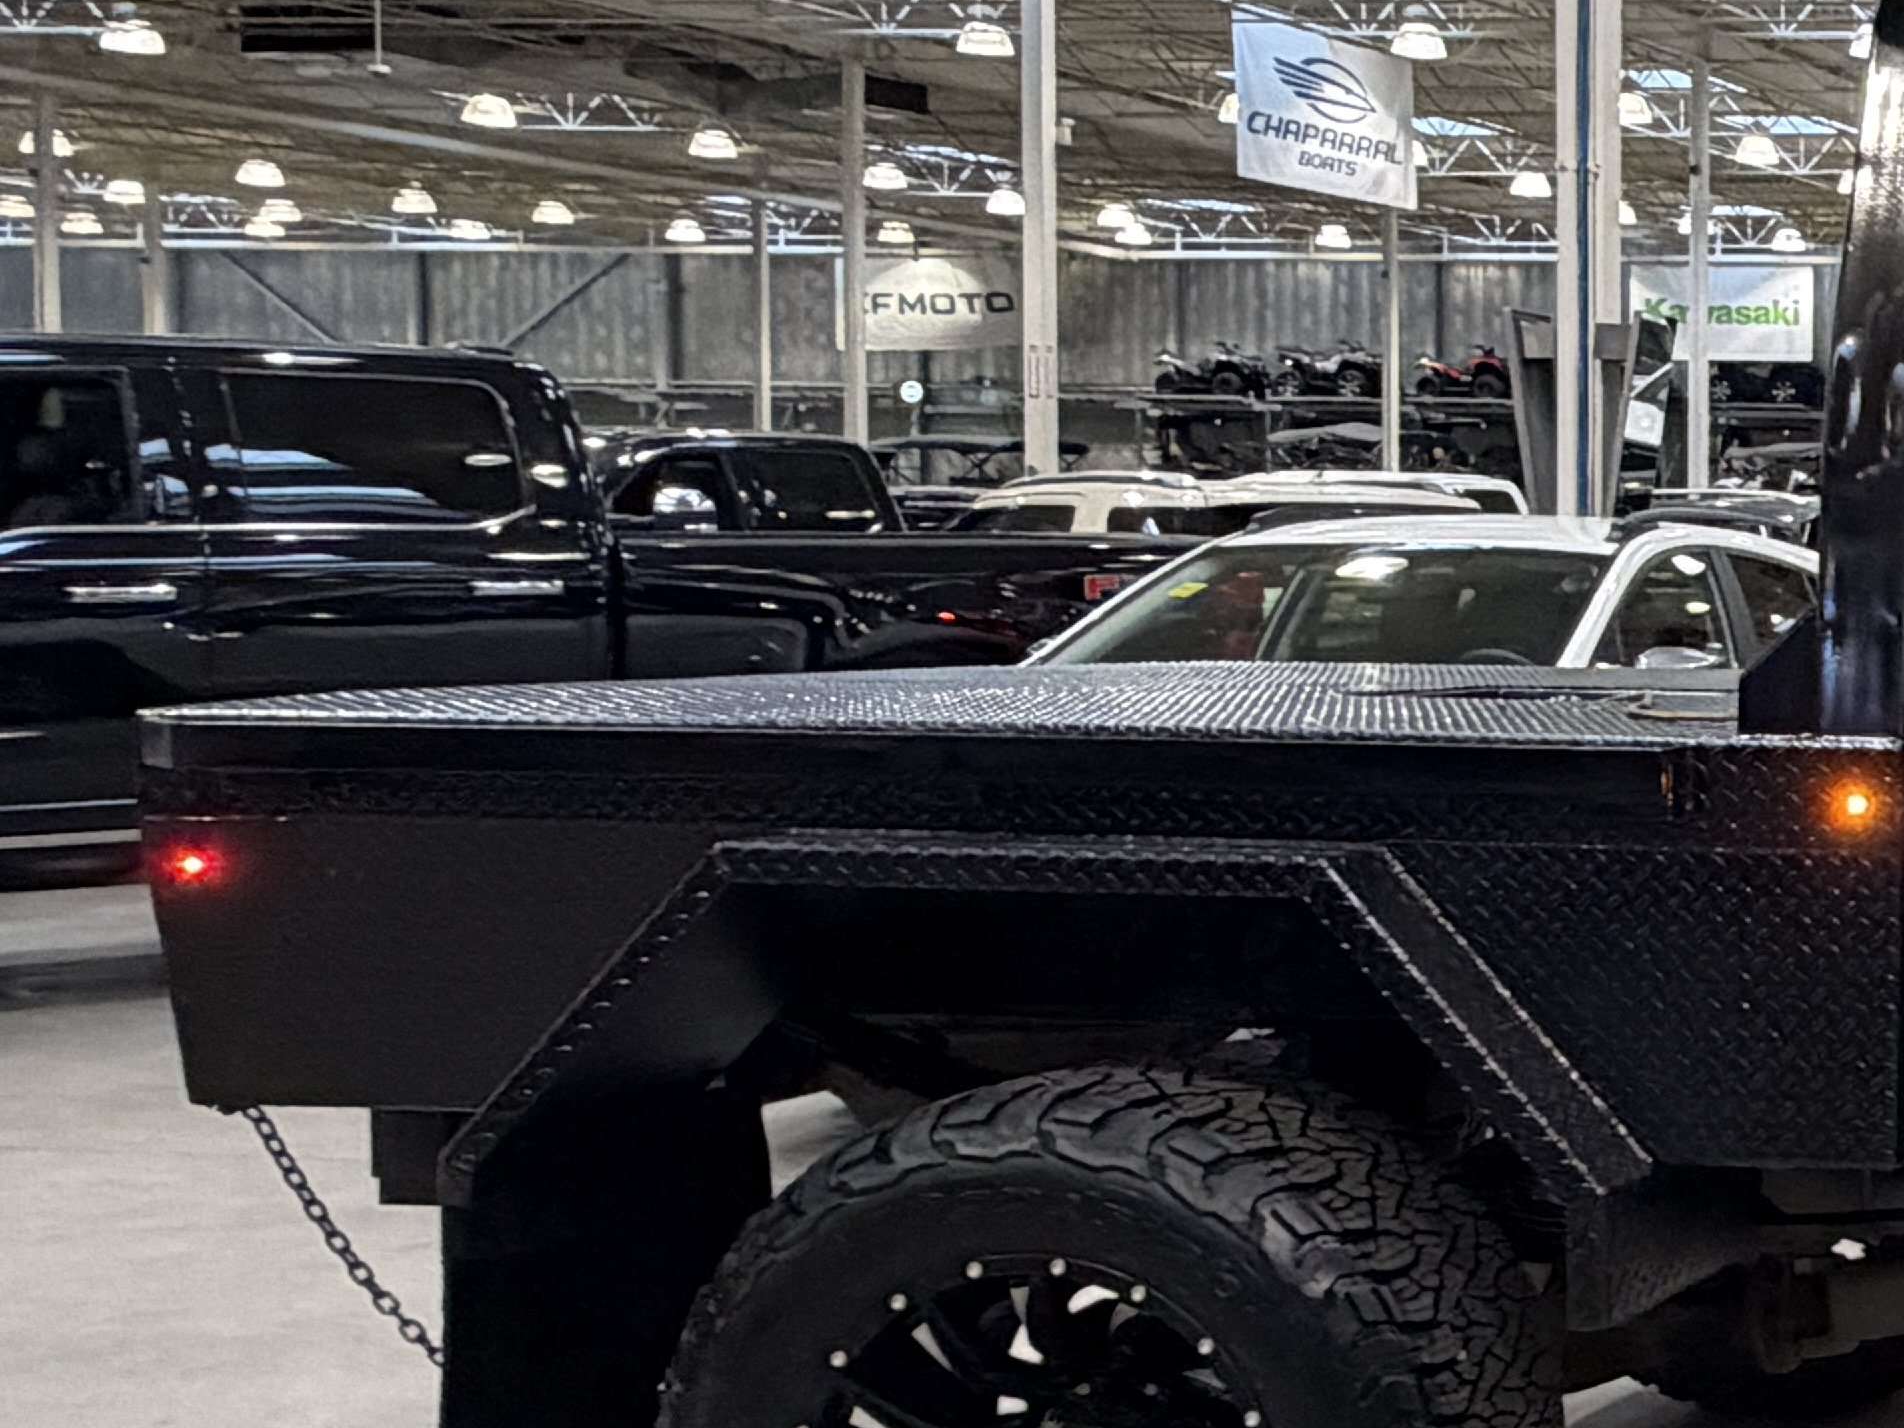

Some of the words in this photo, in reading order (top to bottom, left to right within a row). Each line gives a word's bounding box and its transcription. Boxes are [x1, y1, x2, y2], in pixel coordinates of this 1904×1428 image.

[1246, 110, 1403, 165] CHAPARRAL
[1298, 150, 1359, 176] BOATS
[864, 291, 1015, 315] FMOTO
[1643, 297, 1800, 326] Kaasaki
